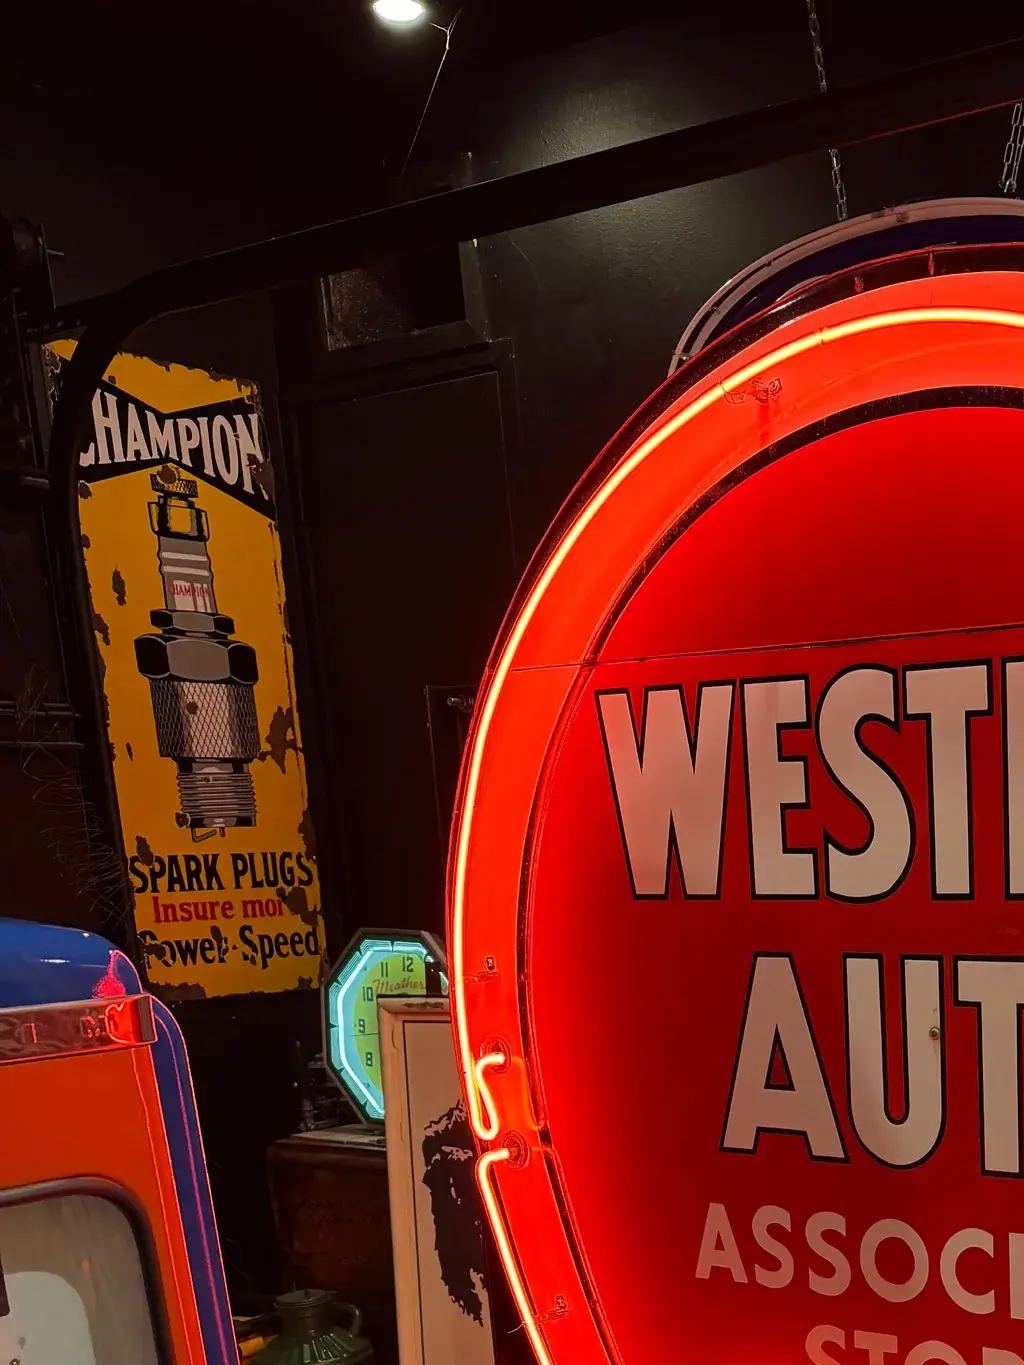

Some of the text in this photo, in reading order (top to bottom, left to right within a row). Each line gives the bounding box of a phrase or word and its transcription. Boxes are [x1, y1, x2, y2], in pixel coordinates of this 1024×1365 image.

[129, 851, 314, 894] SPARK PLUGS
[152, 896, 290, 924] Insure mor
[380, 961, 388, 978] 11
[402, 956, 414, 973] 12
[362, 986, 374, 1002] 10
[358, 1018, 366, 1034] 9
[365, 1051, 373, 1067] 8
